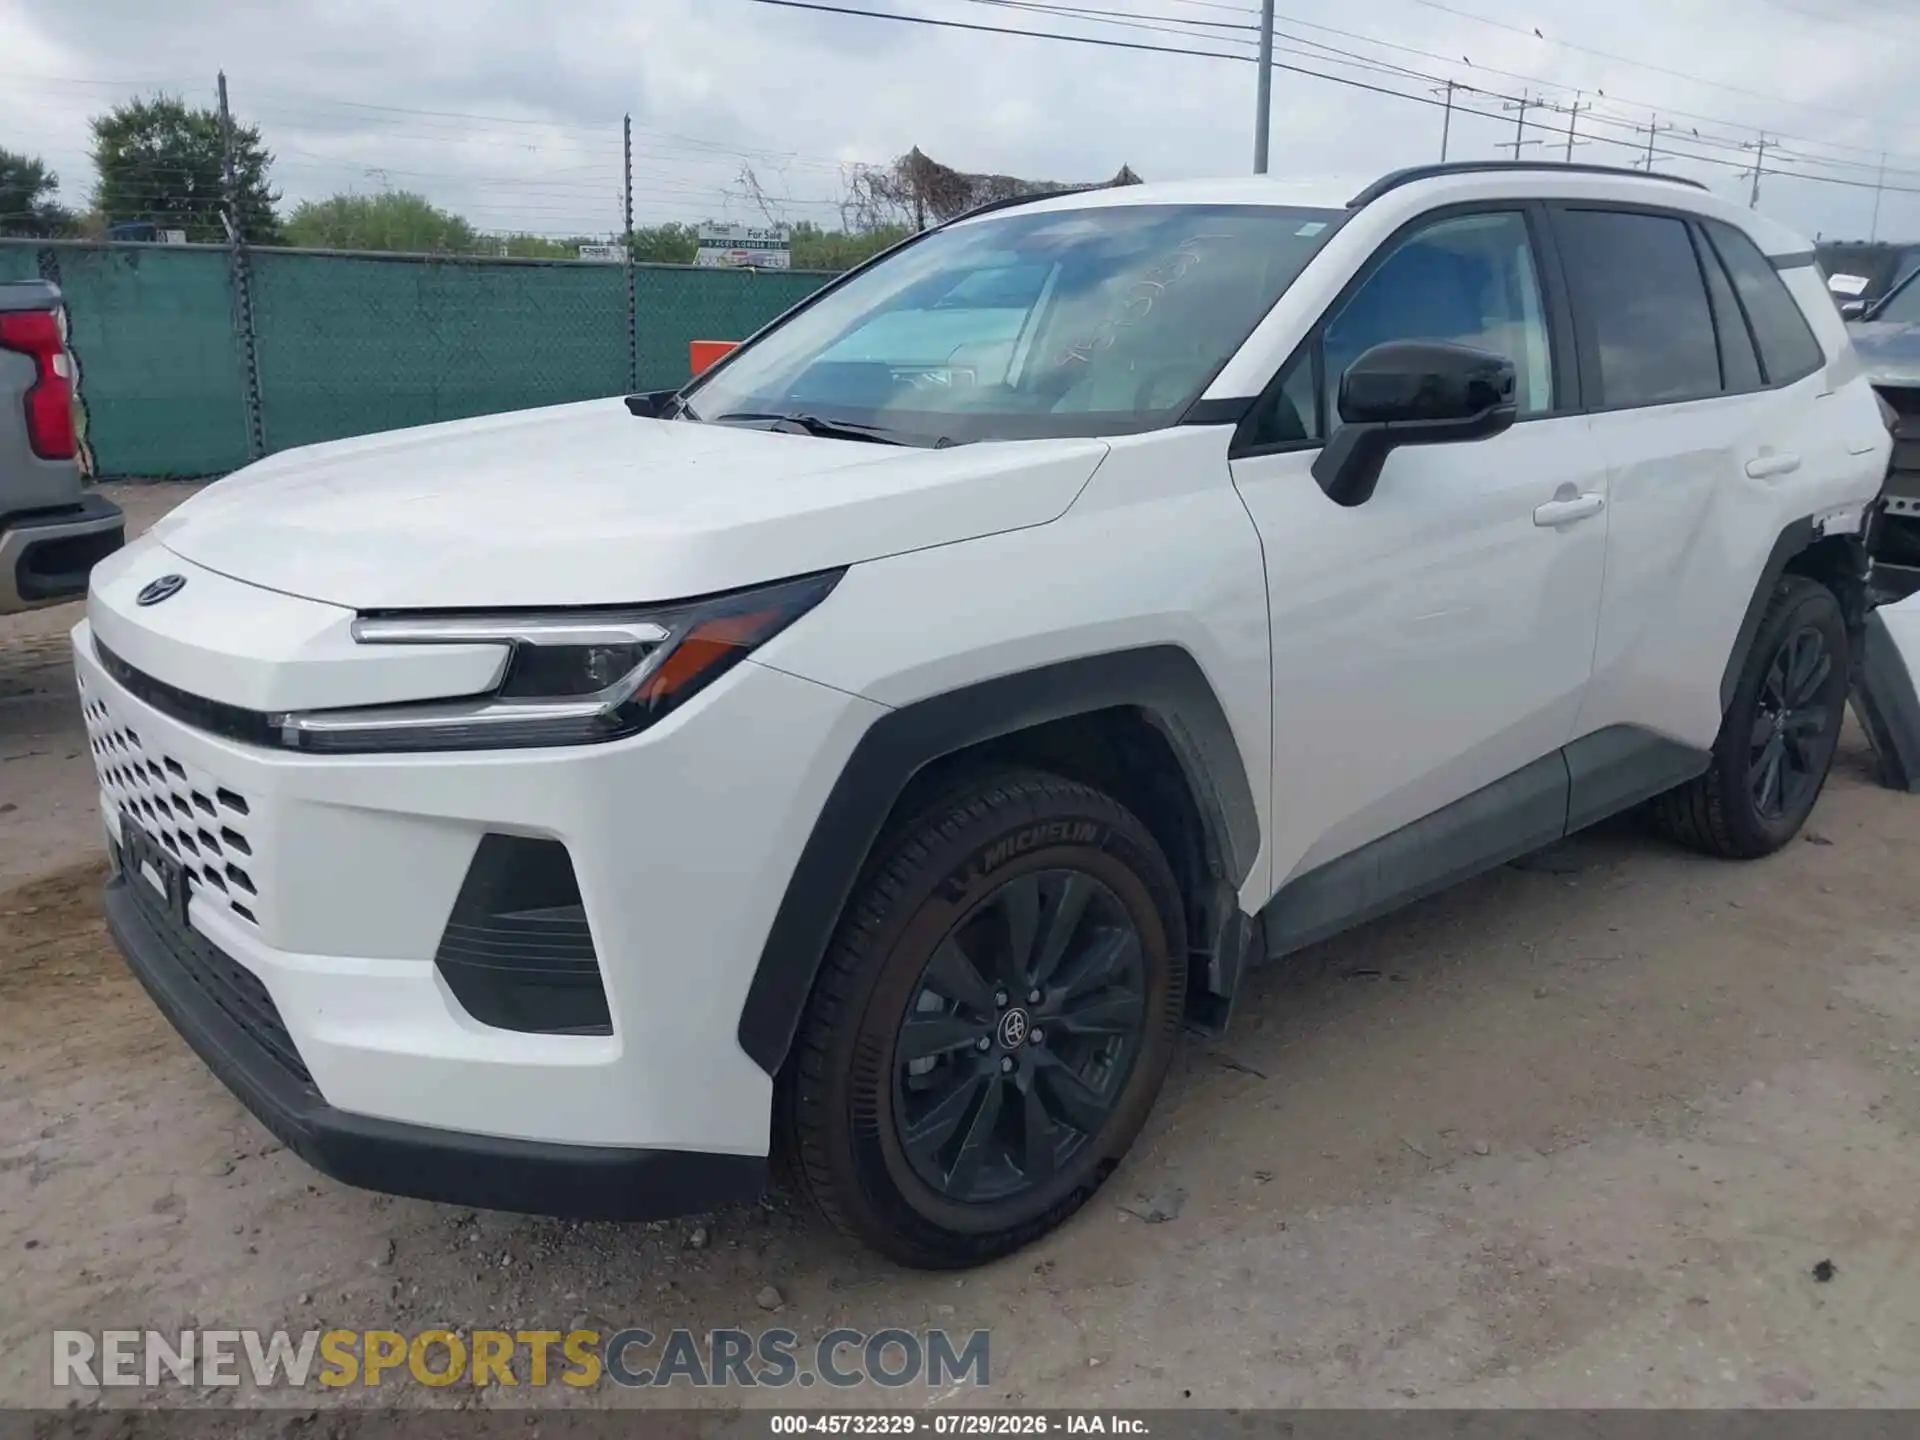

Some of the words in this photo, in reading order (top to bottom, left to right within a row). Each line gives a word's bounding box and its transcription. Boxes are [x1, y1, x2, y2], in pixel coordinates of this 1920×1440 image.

[747, 228, 762, 240] For
[765, 229, 782, 240] Sale
[983, 821, 1098, 873] MICHELIN
